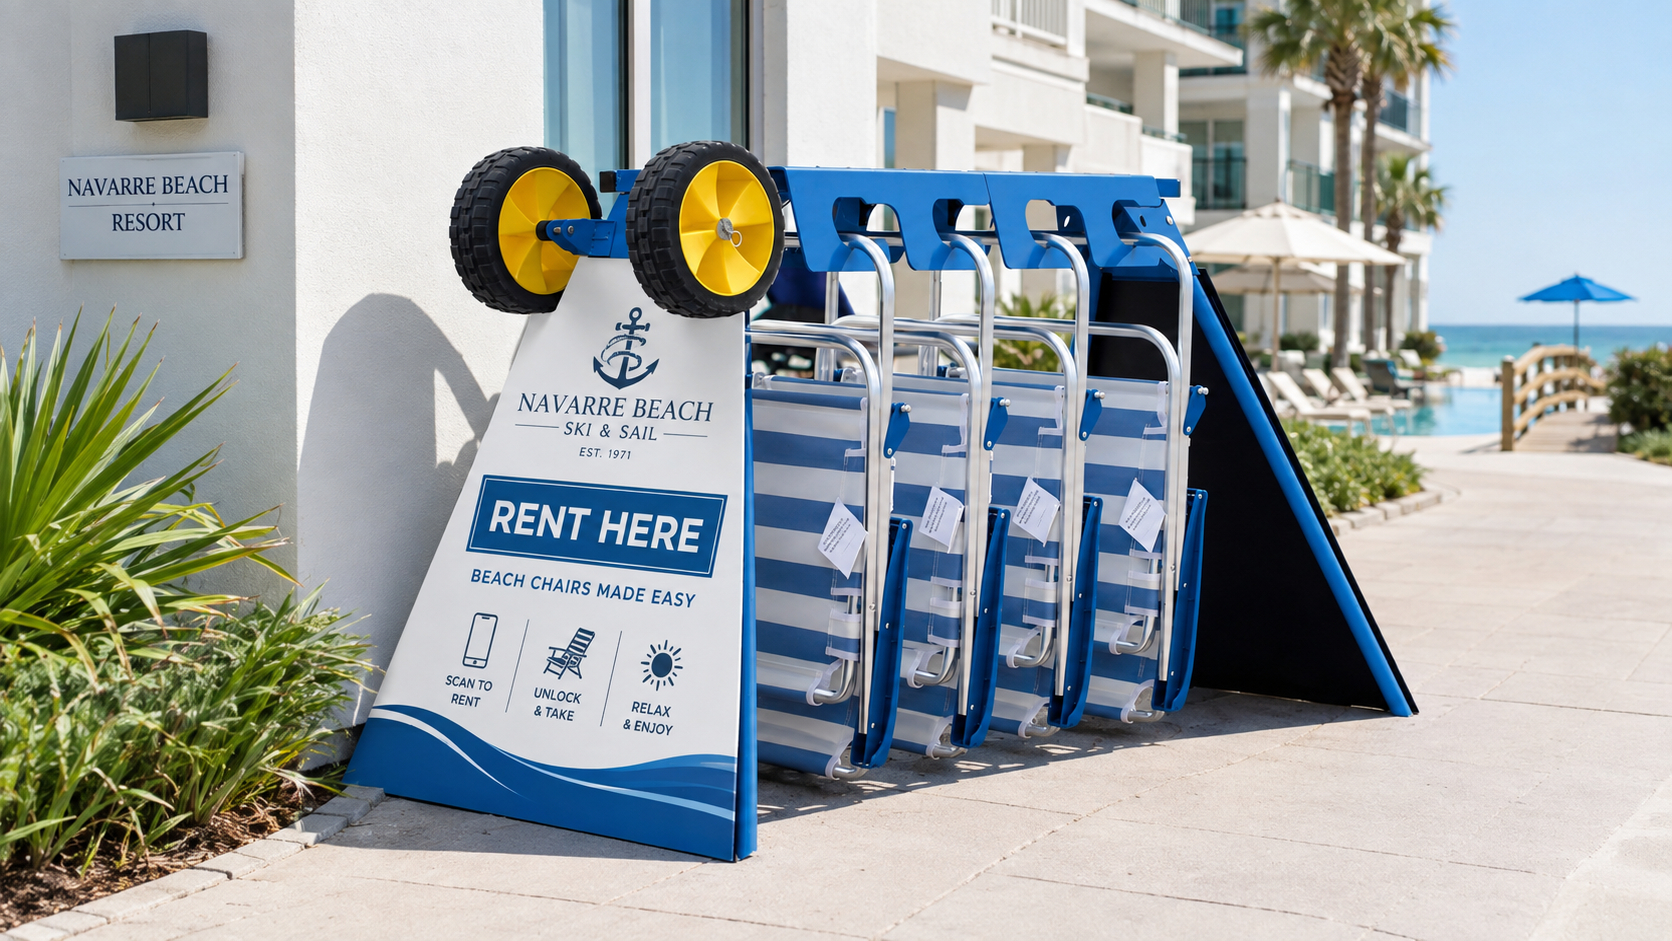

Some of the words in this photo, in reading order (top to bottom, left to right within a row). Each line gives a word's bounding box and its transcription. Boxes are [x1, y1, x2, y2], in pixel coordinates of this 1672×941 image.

[68, 177, 156, 196] NAVARRE
[162, 174, 228, 194] BEACH
[112, 212, 186, 232] RESORT
[518, 392, 626, 417] NAVARRE
[632, 398, 714, 422] BEACH
[564, 422, 592, 436] SKI
[600, 424, 610, 438] &
[620, 425, 657, 440] SAIL
[579, 447, 602, 458] EST.
[608, 449, 631, 460] 1971
[489, 500, 592, 540] RENT
[598, 510, 704, 553] HERE
[470, 568, 526, 588] BEACH
[530, 576, 591, 596] CHAIRS
[596, 584, 646, 602] MADE
[651, 590, 696, 608] EASY
[446, 675, 476, 688] SCAN
[478, 680, 493, 692] TO
[450, 694, 480, 708] RENT
[534, 688, 582, 704] UNLOCK
[534, 706, 542, 716] &
[545, 707, 574, 722] TAKE
[632, 702, 671, 718] RELAX
[623, 719, 631, 730] &
[634, 721, 674, 736] ENJOY
